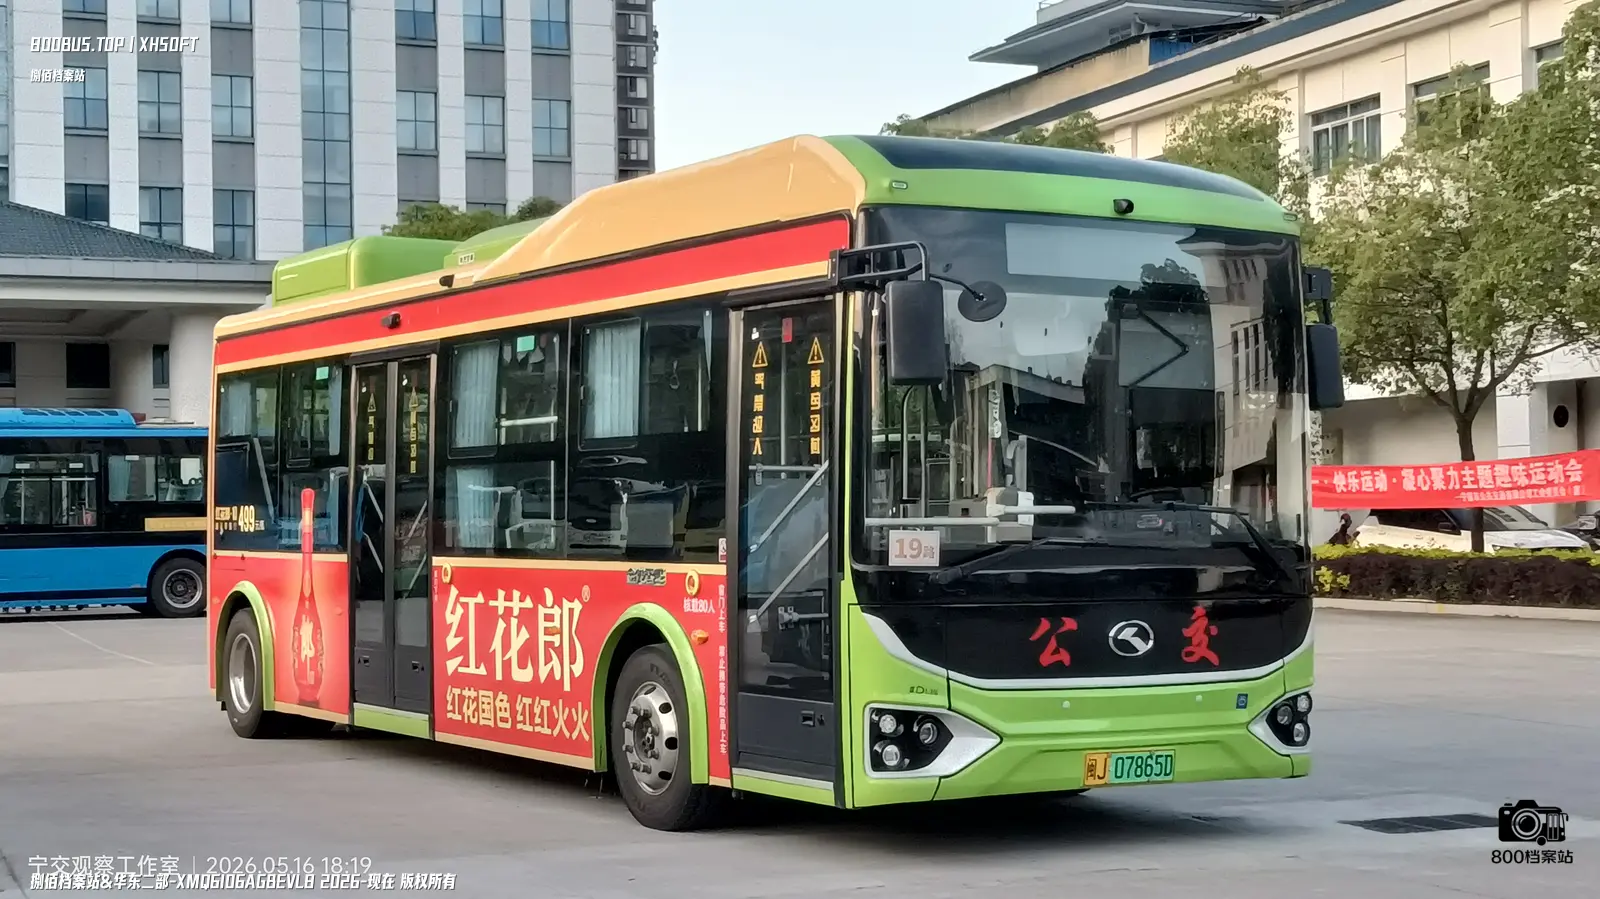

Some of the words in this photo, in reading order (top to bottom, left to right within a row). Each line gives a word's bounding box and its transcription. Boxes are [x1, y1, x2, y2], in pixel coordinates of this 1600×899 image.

[238, 505, 256, 532] 499
[445, 584, 584, 692] 红花郎
[446, 685, 512, 729] 红花国色
[516, 694, 590, 742] 红红火火
[1114, 754, 1173, 779] 07865D
